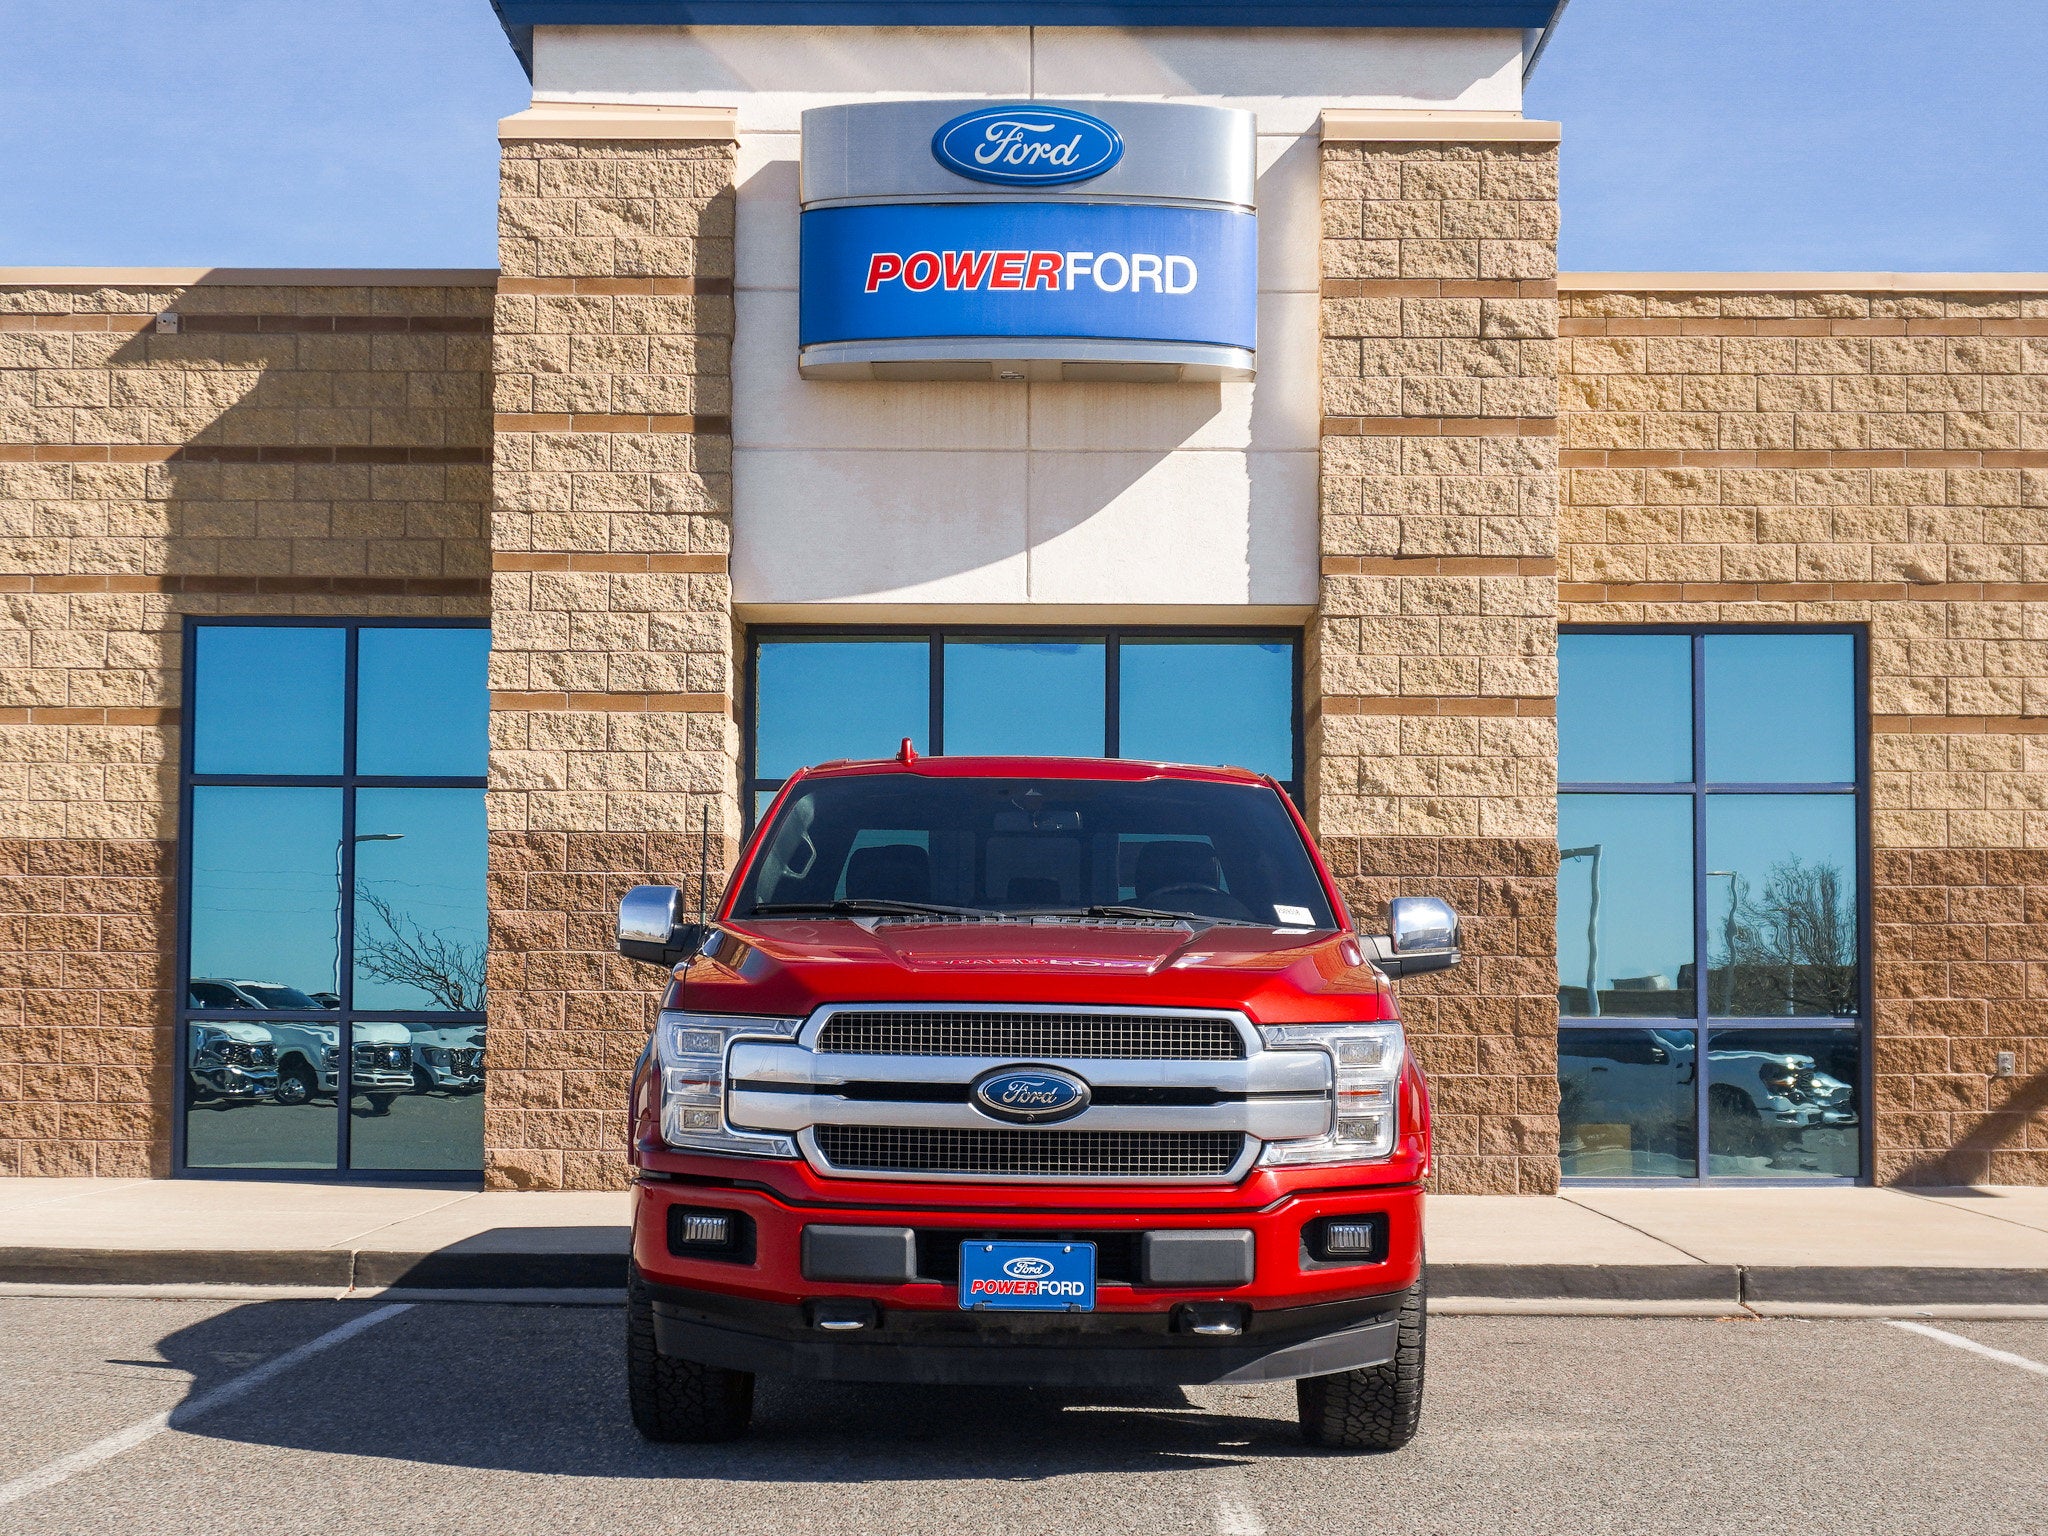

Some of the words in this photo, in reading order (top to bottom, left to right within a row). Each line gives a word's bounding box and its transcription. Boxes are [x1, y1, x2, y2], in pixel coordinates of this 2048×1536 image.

[974, 121, 1083, 167] Ford
[864, 250, 1199, 295] POWERFORD
[1002, 1080, 1059, 1105] Ford
[1013, 1261, 1044, 1276] Ford
[971, 1279, 1085, 1296] POWERFORD
